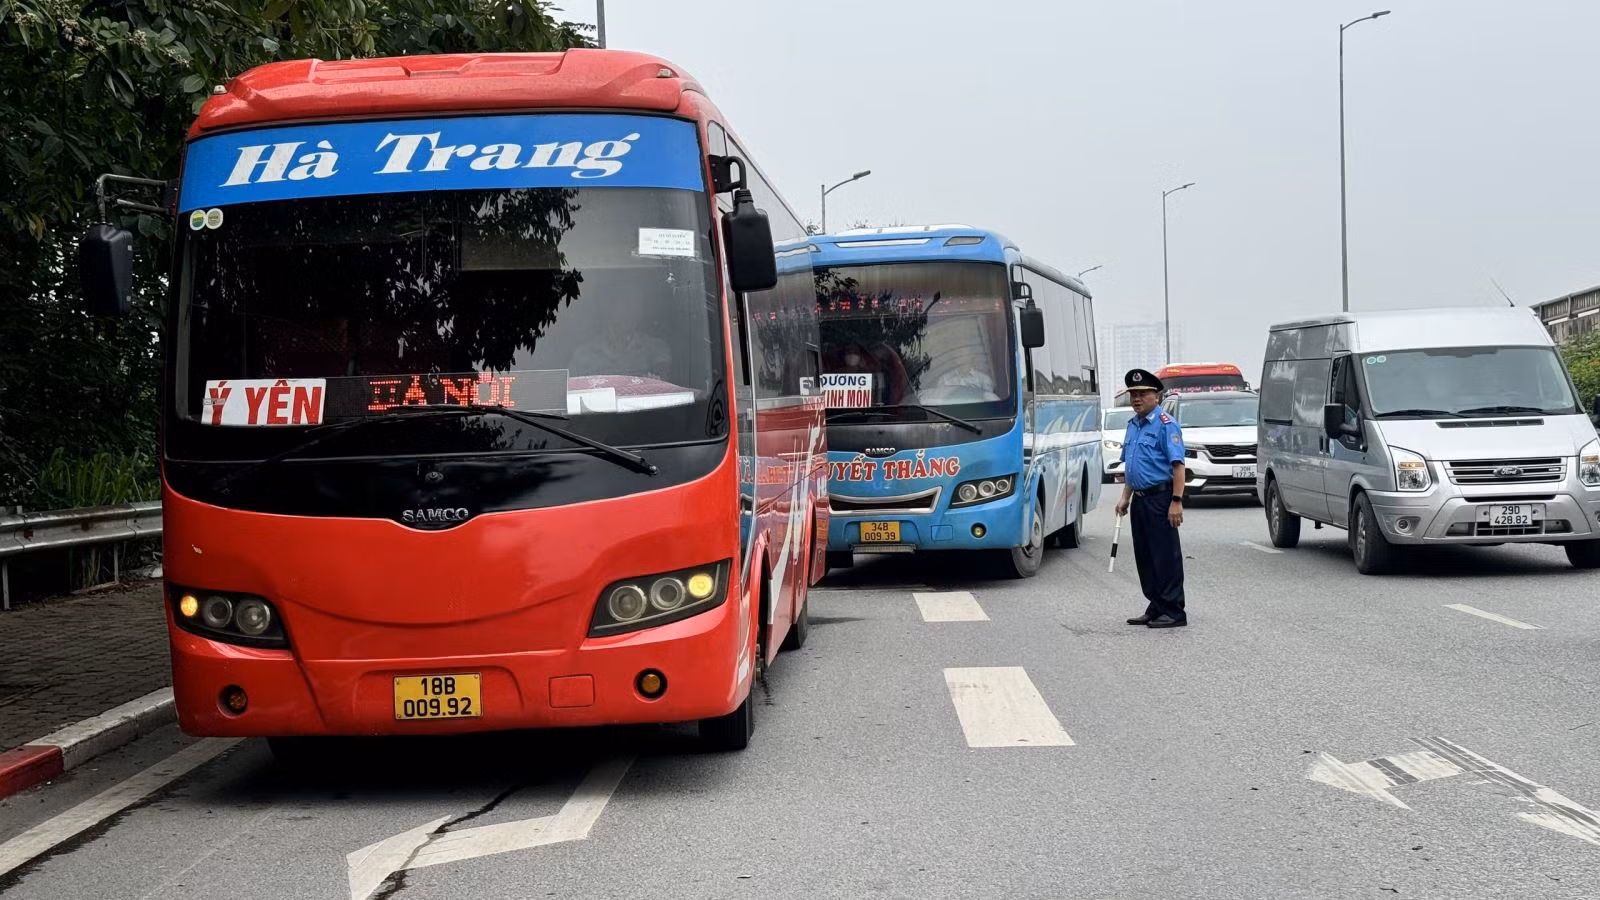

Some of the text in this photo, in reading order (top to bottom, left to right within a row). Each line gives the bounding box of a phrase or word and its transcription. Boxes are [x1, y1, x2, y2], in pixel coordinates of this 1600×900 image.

[218, 131, 641, 187] Hà Trang
[209, 379, 321, 425] Ý YÊN
[824, 389, 844, 408] INH
[866, 447, 896, 456] SAMCO
[882, 449, 961, 481] THẮNG
[402, 507, 469, 522] SAMCO
[1502, 505, 1520, 515] 29D
[871, 522, 889, 531] 34B
[1494, 515, 1528, 525] 428.82
[864, 531, 896, 541] 009.39
[421, 677, 456, 696] 18B
[403, 697, 472, 717] 009.92
